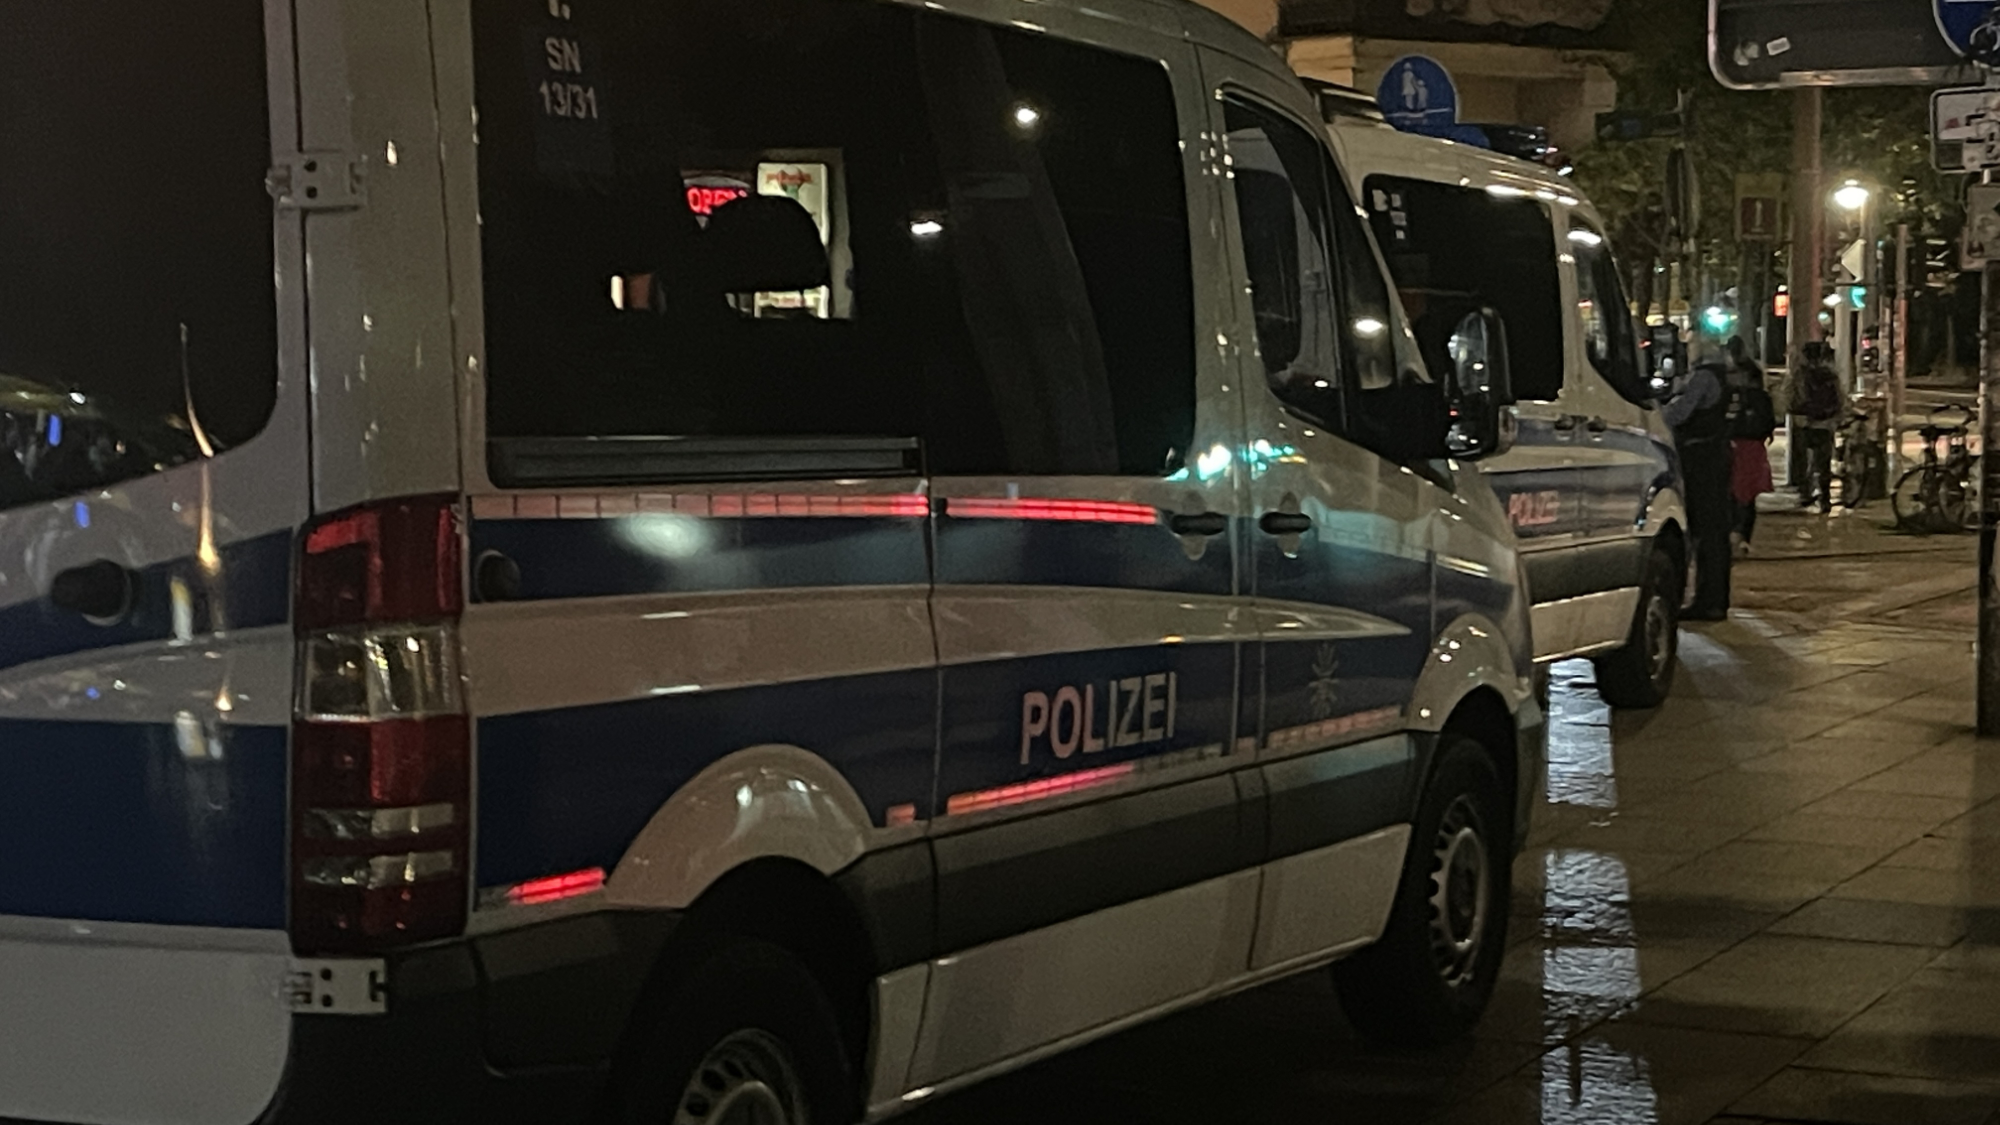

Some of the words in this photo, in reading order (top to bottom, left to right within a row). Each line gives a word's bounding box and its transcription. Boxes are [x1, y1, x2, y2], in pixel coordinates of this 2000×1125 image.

[545, 37, 581, 73] SN
[540, 80, 598, 119] 13/31
[1020, 671, 1177, 764] POLIZEI
